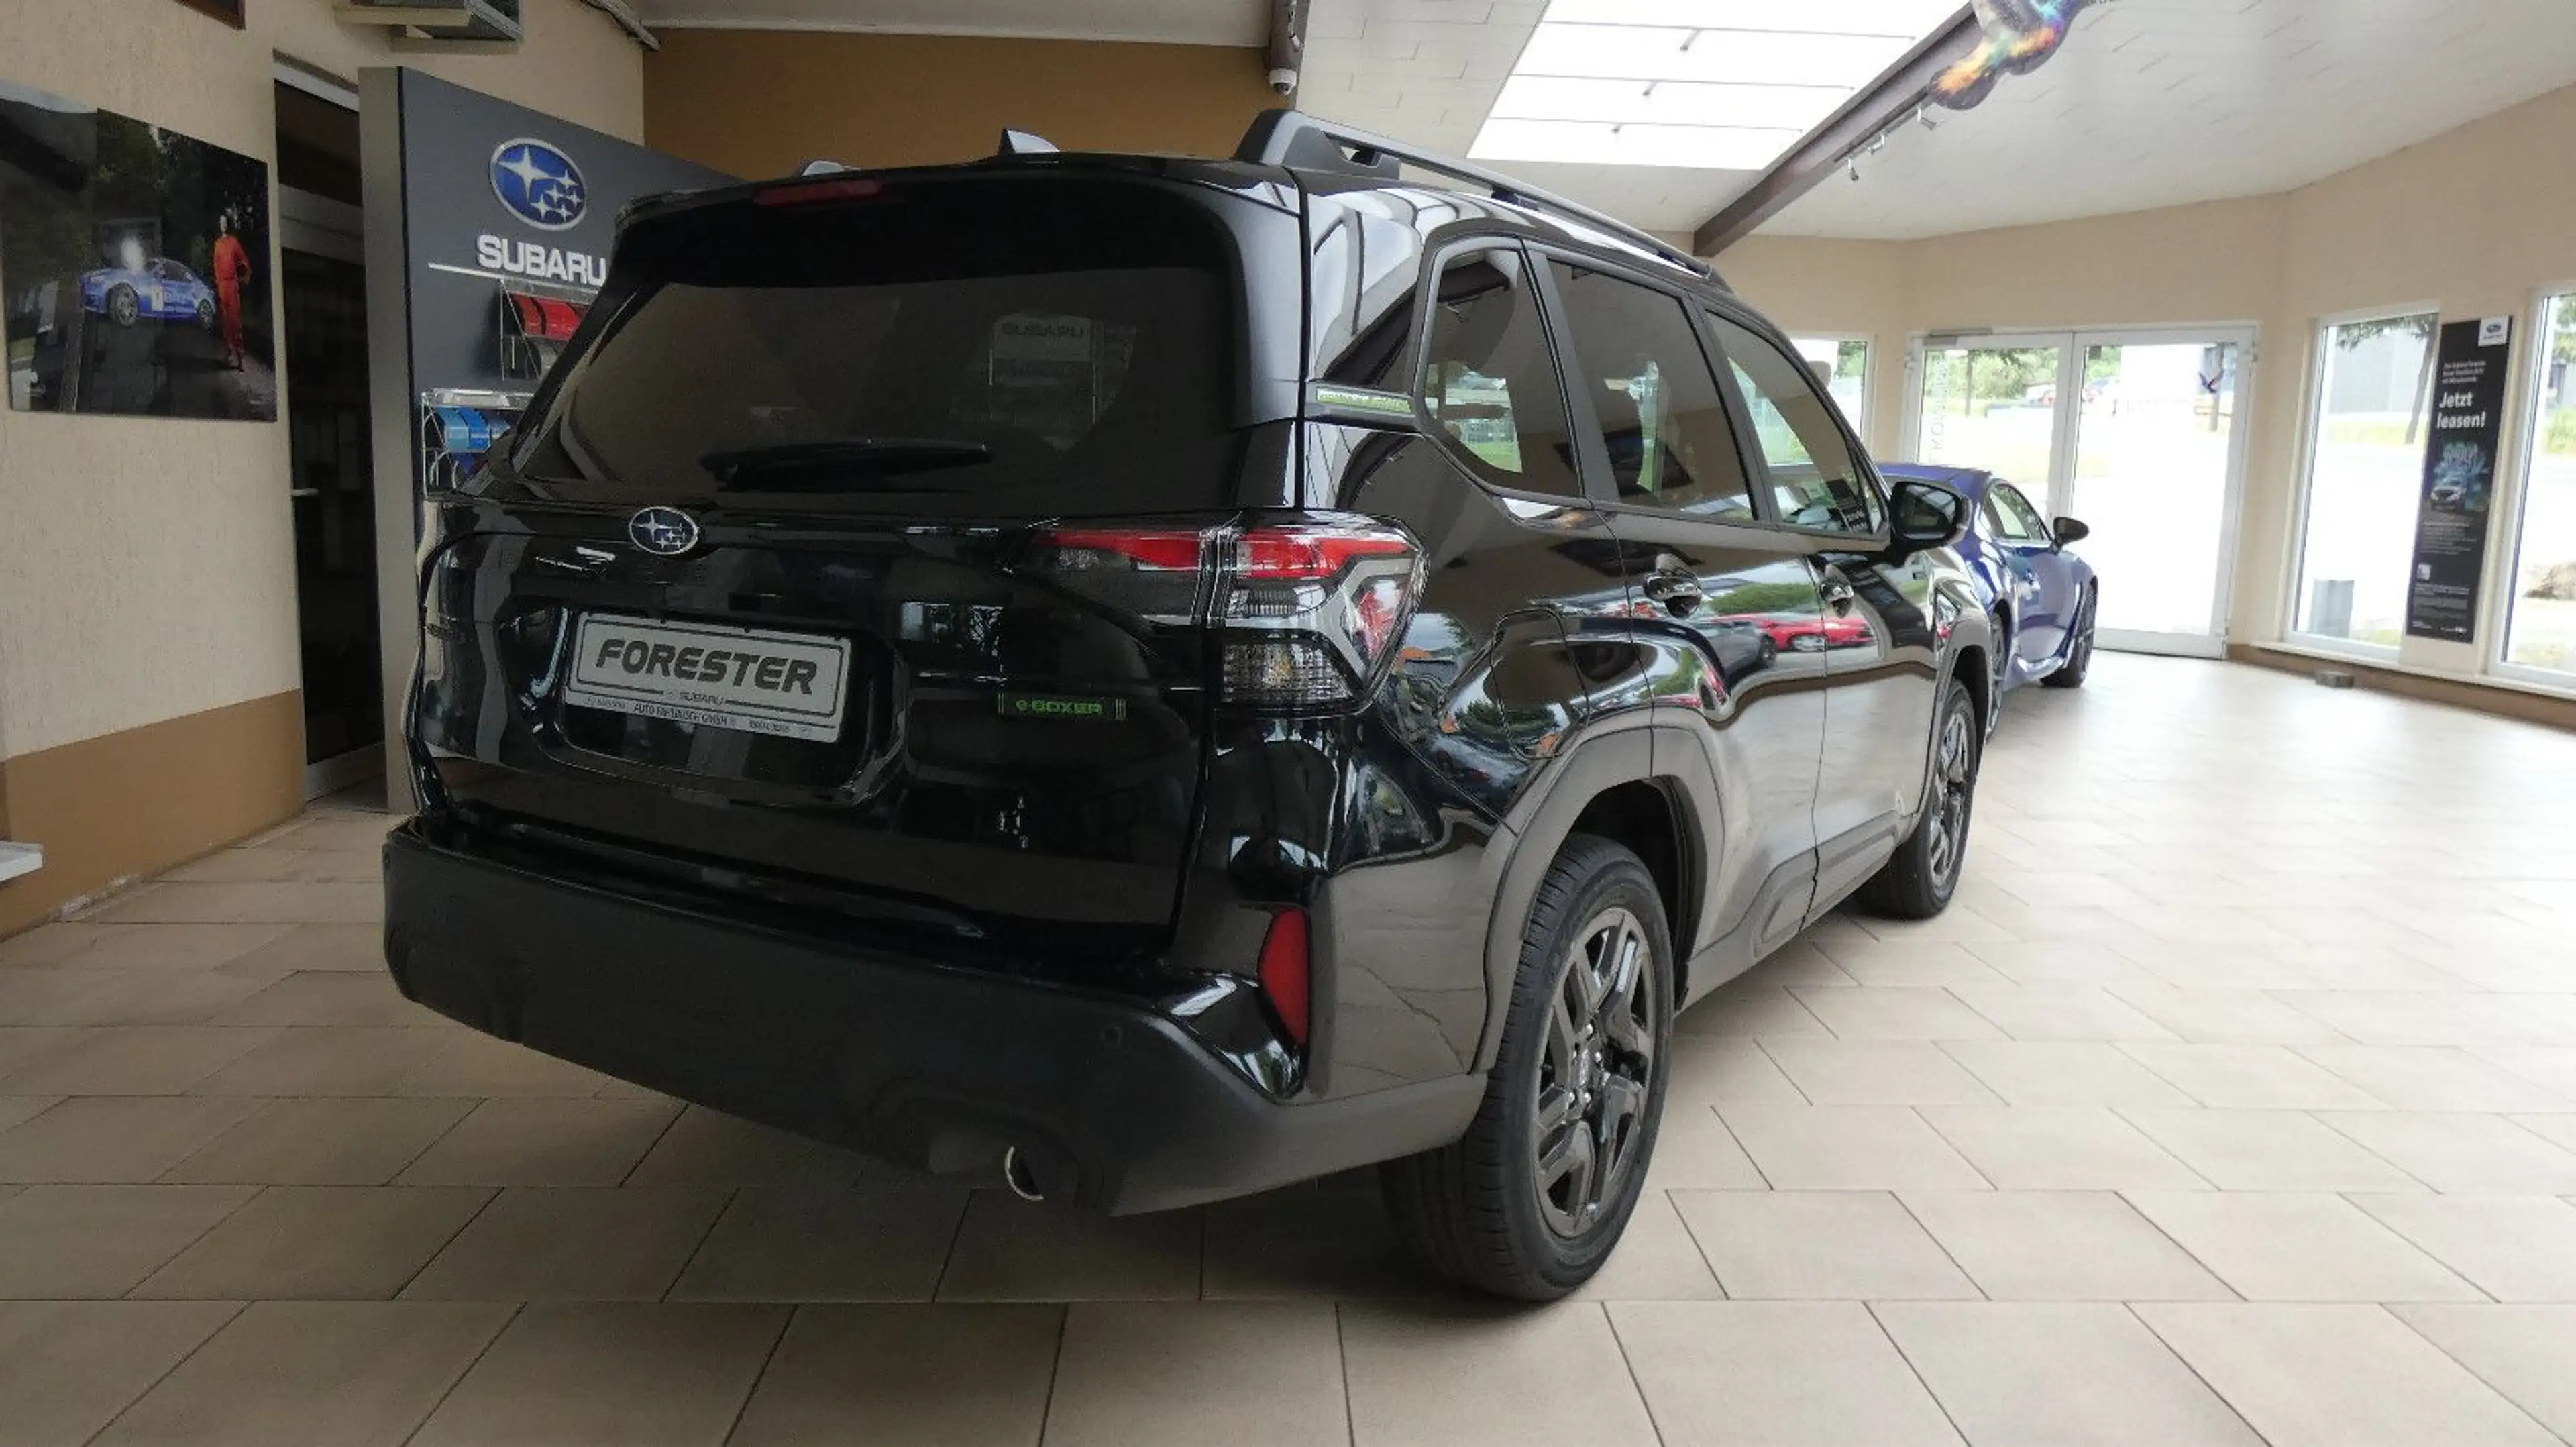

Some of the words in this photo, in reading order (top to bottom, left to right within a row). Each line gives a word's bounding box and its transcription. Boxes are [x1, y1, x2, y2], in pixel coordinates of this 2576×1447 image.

[477, 235, 607, 286] SUBARU
[2439, 392, 2473, 409] Jetzt
[2436, 411, 2487, 429] leasen!
[595, 639, 817, 694] FORESTER
[680, 691, 724, 706] SUBARU
[633, 703, 655, 715] AUTO
